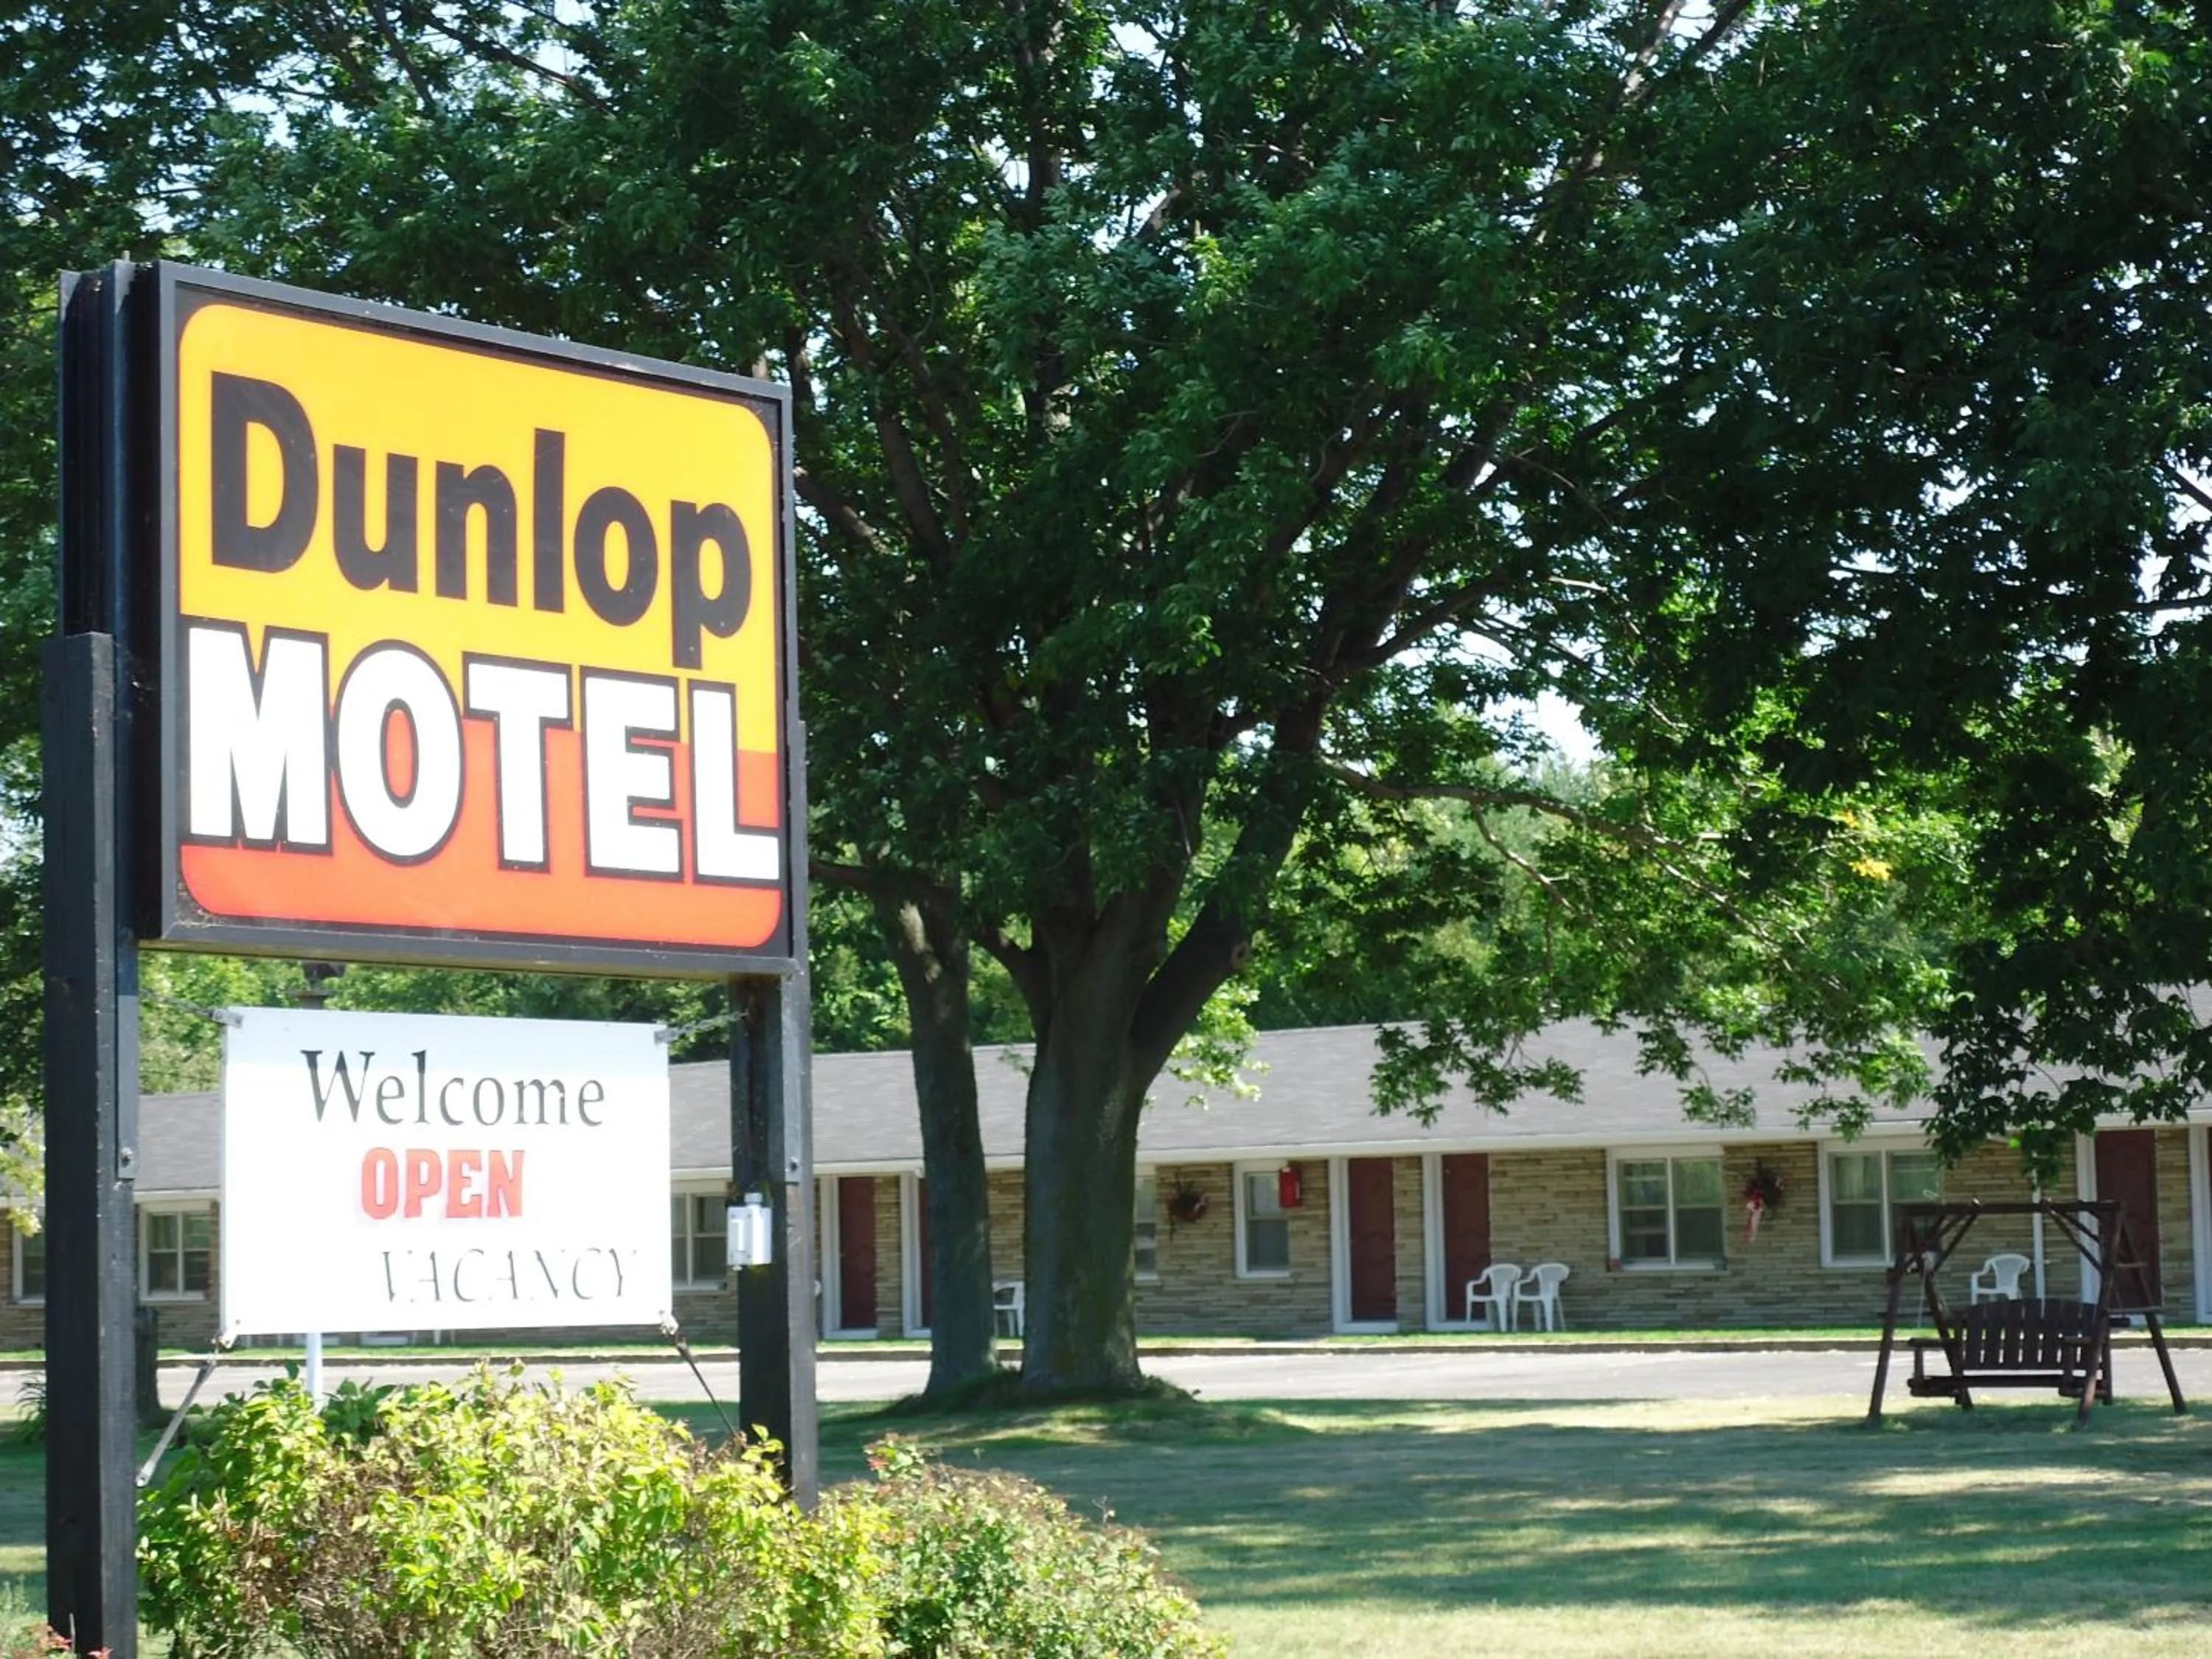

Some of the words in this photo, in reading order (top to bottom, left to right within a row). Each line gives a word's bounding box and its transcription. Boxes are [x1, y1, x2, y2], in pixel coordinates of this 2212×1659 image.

[210, 370, 751, 669] Dunlop
[186, 622, 781, 884] MOTEL
[300, 1049, 605, 1127] Welcome
[361, 1147, 525, 1220] OPEN
[381, 1247, 639, 1304] VACANCY
